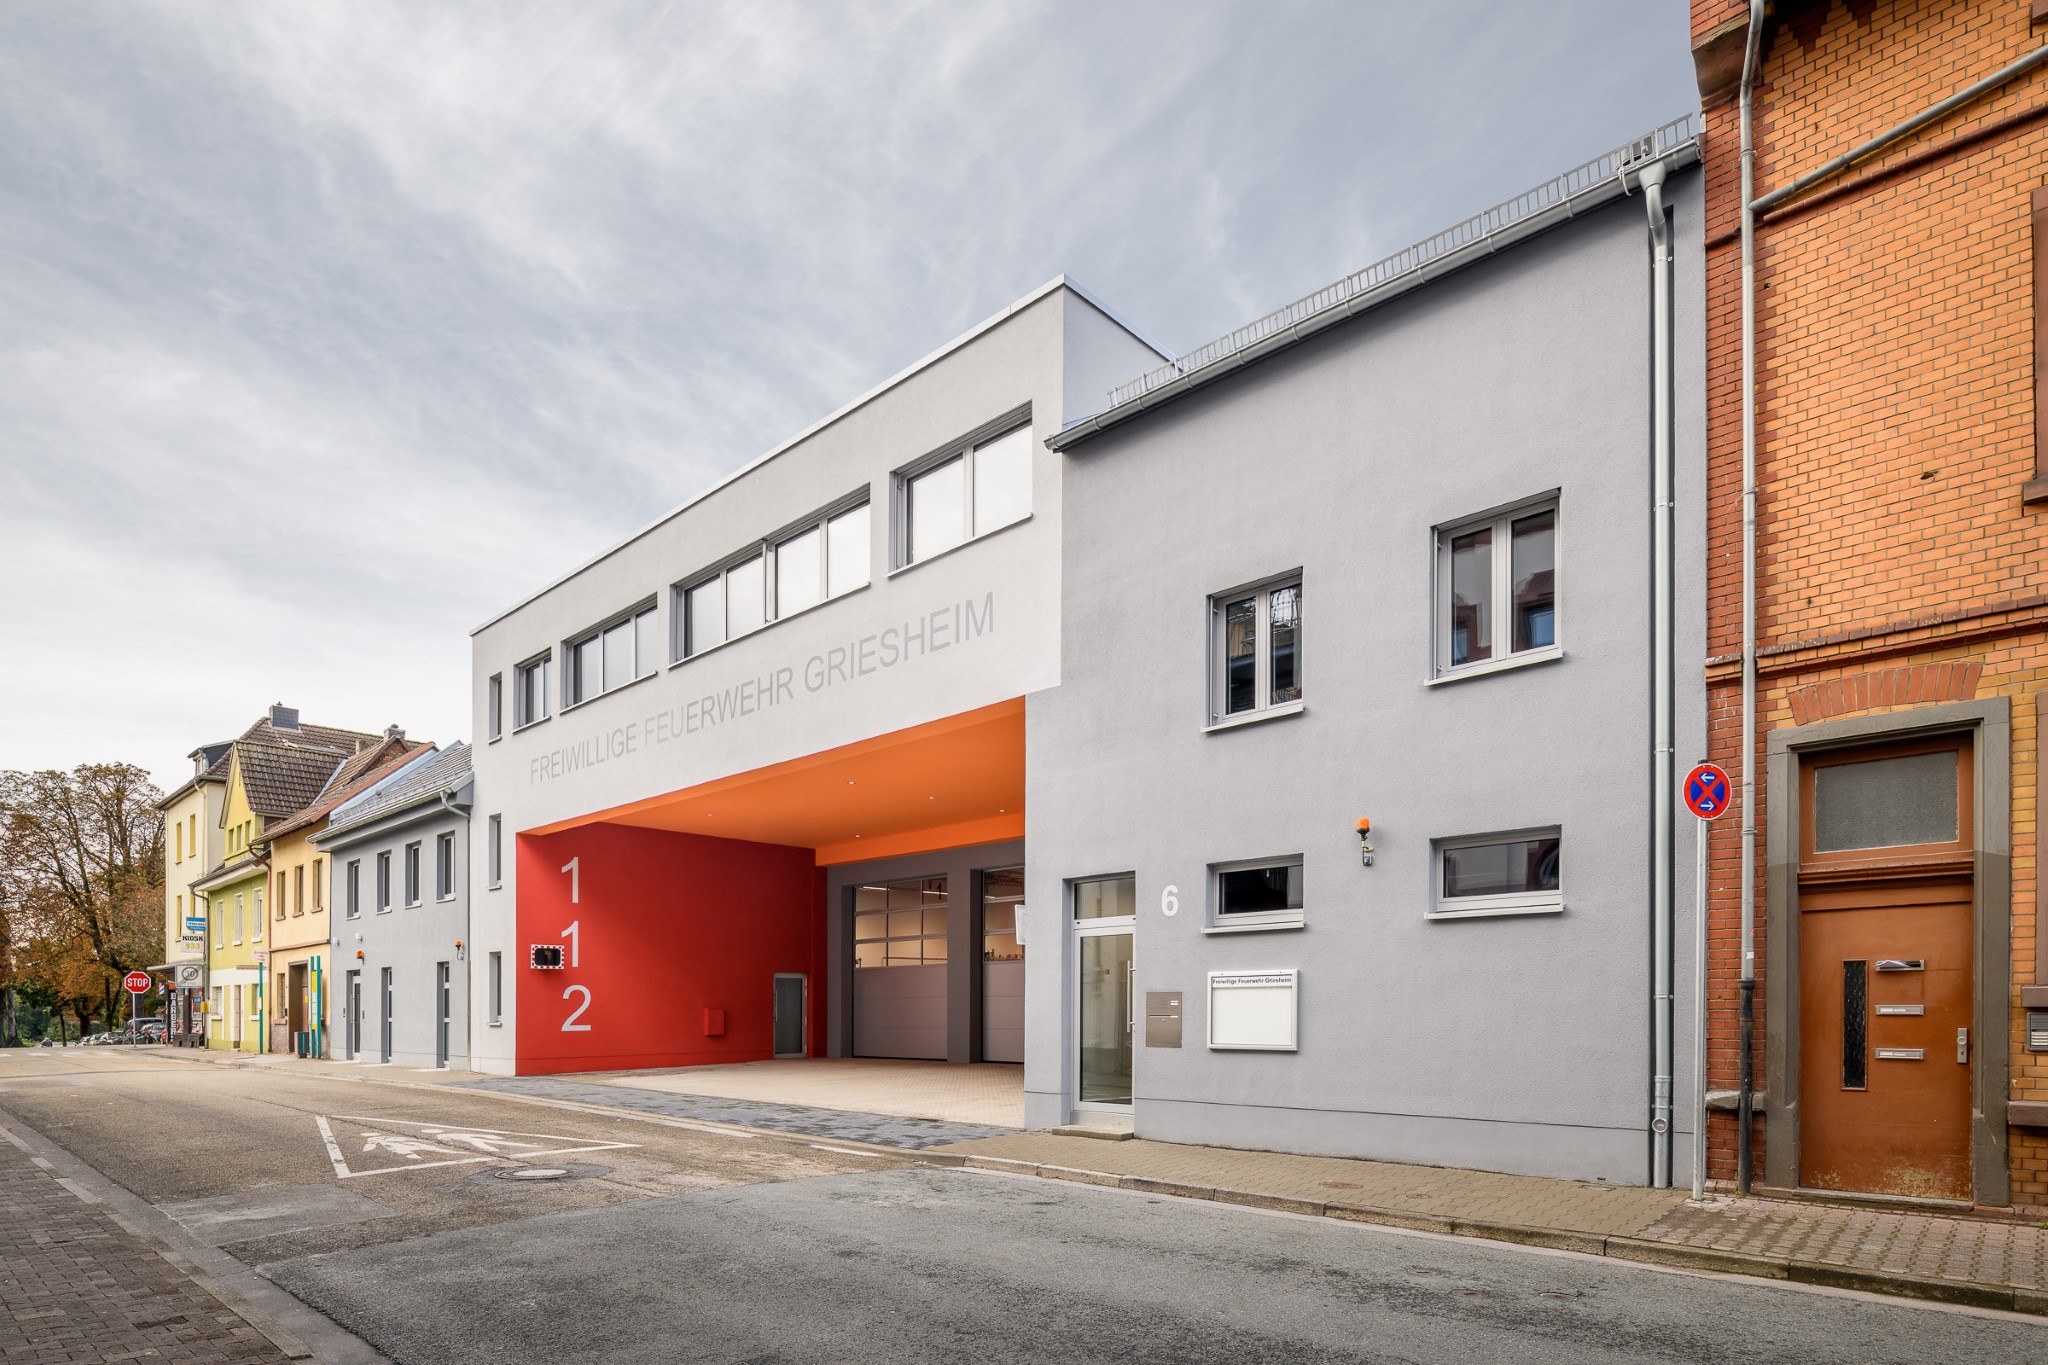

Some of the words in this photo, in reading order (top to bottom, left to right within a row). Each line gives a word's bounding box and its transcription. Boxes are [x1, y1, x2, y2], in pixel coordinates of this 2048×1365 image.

[530, 723, 637, 785] FREIWILLIGE
[644, 667, 794, 748] FEUERWEHR
[804, 591, 994, 693] GRIESHEIM
[1161, 885, 1179, 916] 6
[127, 977, 149, 987] STOP
[1265, 976, 1292, 984] Griesheim
